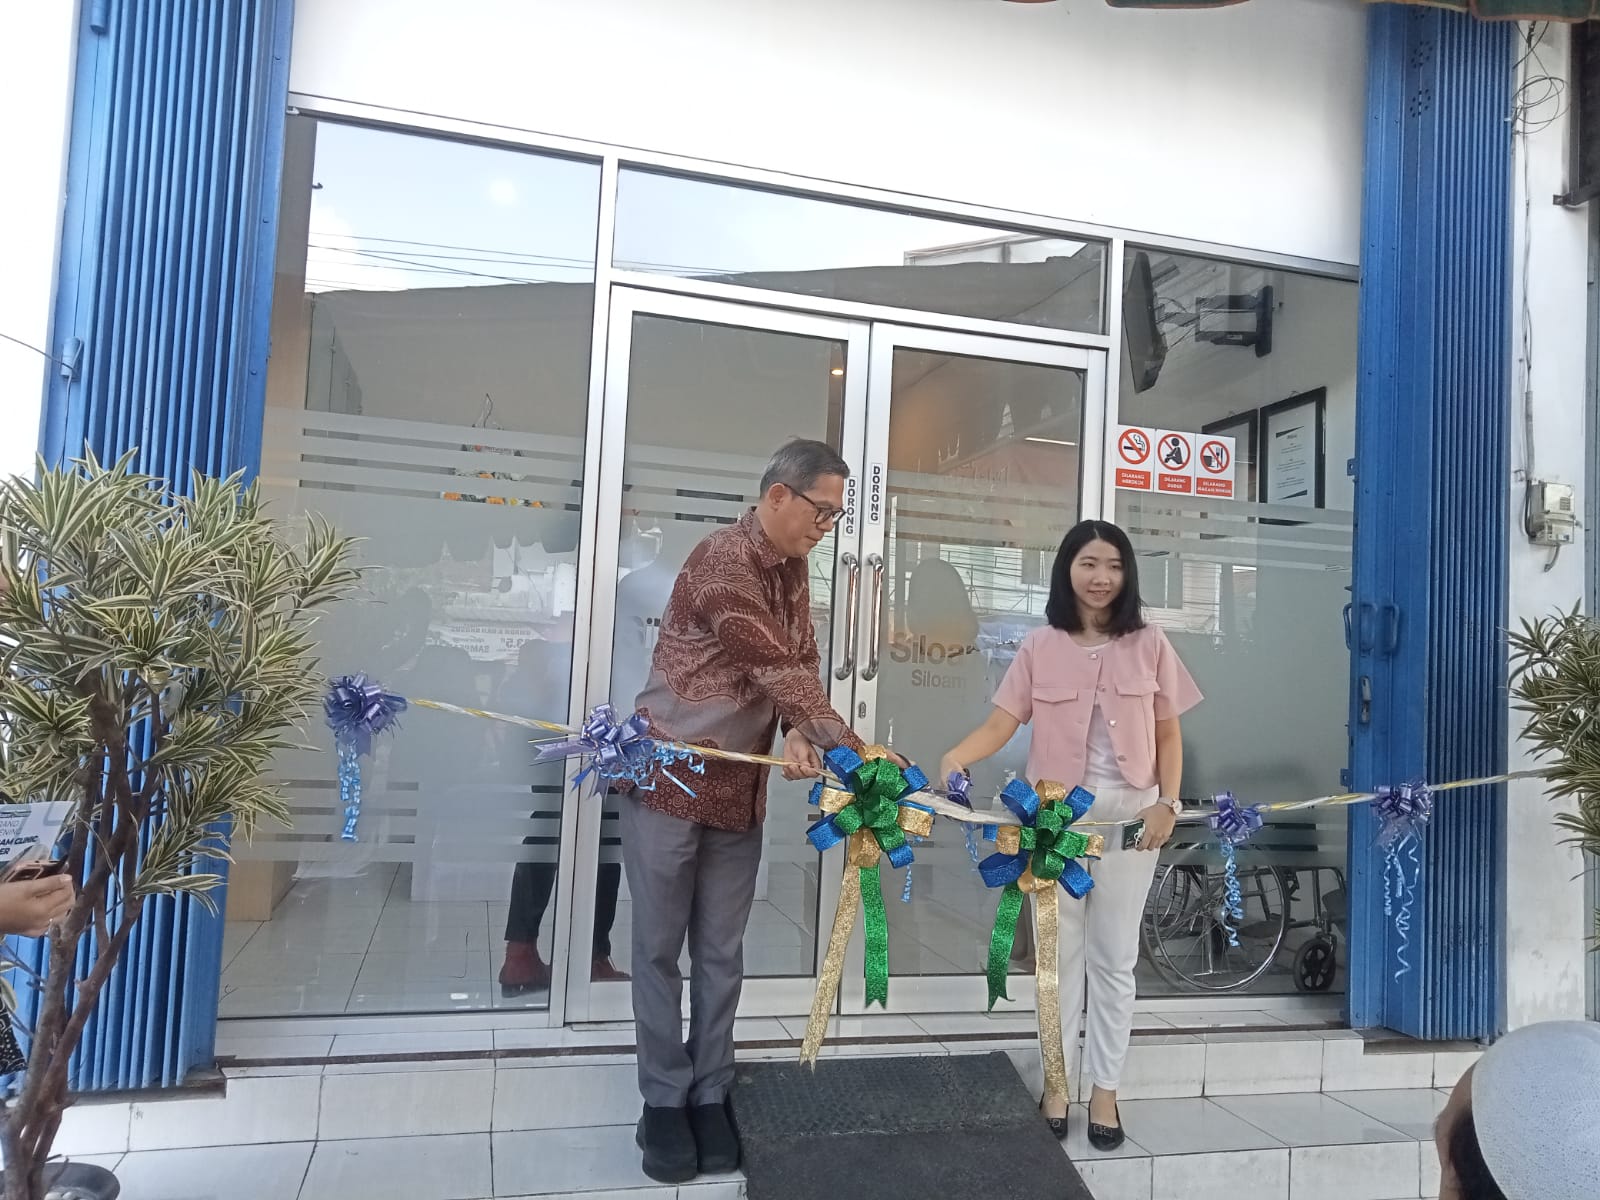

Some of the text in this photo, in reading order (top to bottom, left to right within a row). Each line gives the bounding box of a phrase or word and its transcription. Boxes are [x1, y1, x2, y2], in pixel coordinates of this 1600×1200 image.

[845, 478, 856, 535] DORONG
[871, 465, 881, 522] DORONG
[911, 669, 969, 688] Siloam
